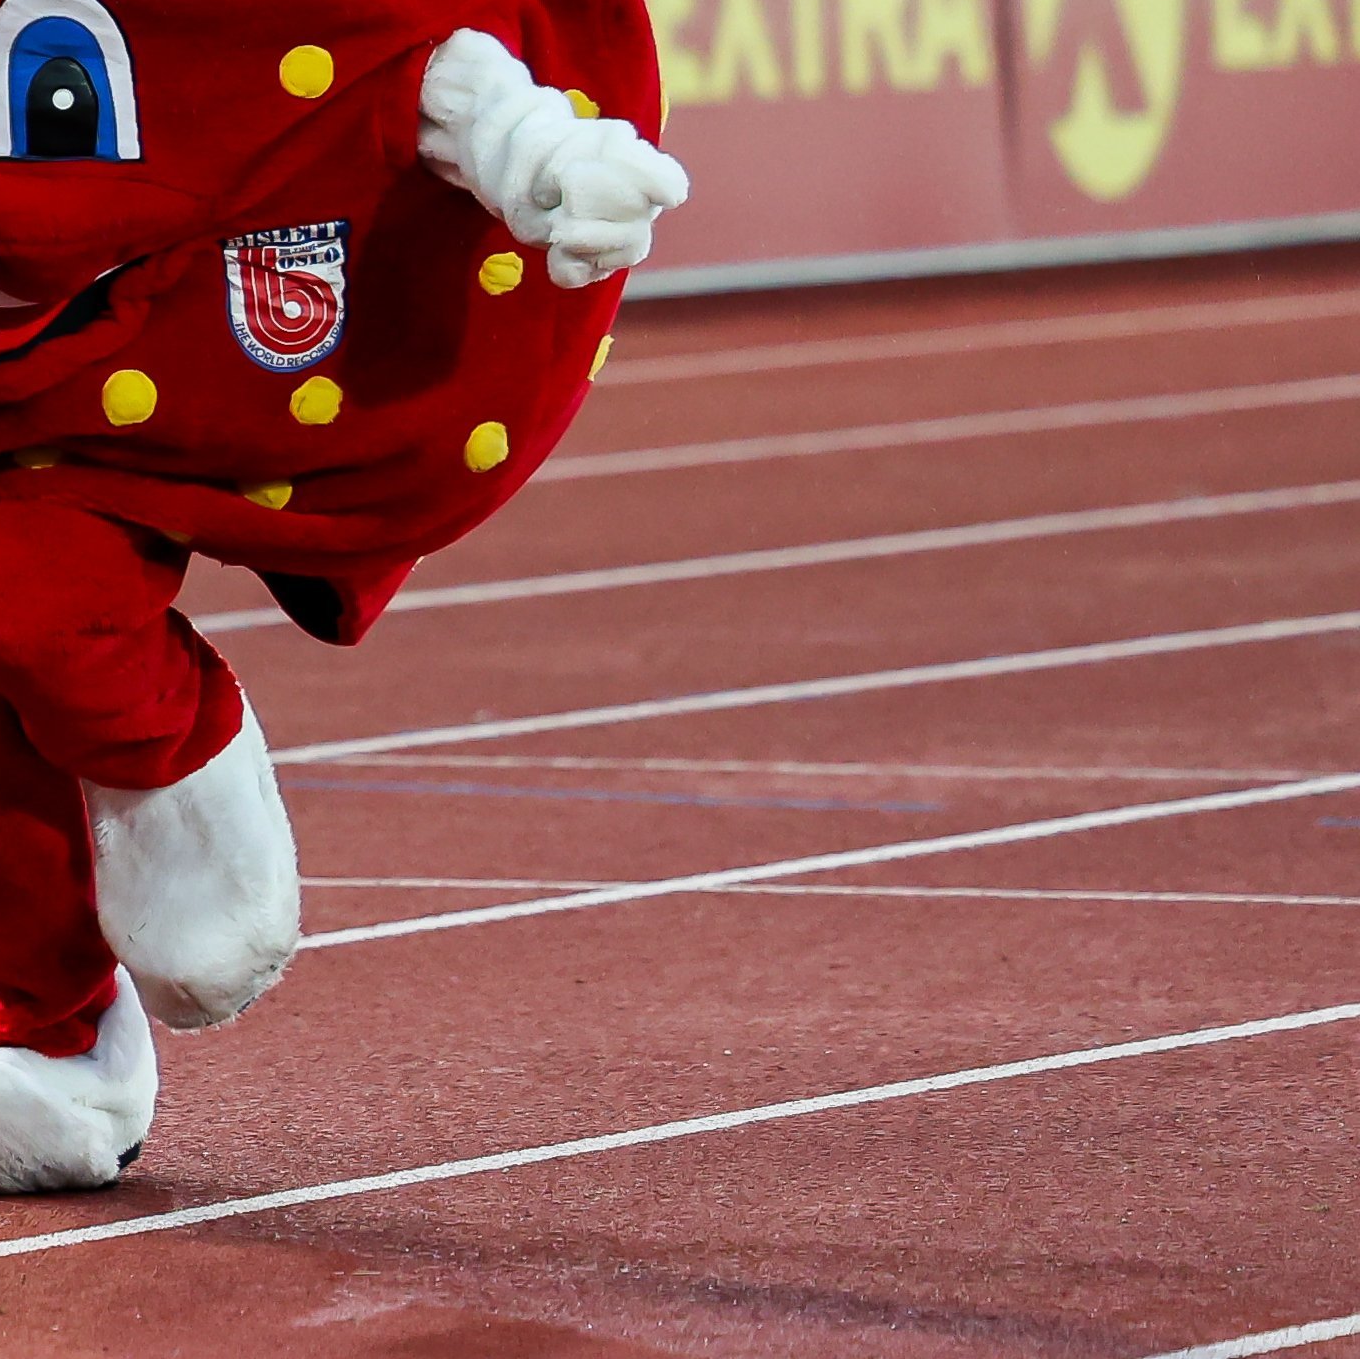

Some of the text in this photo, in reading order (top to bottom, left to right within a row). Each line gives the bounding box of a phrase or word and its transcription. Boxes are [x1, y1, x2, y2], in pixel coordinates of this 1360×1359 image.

[278, 247, 340, 269] OSLO
[234, 321, 252, 343] THE
[247, 341, 286, 367] WORLD
[286, 340, 332, 367] RECORD
